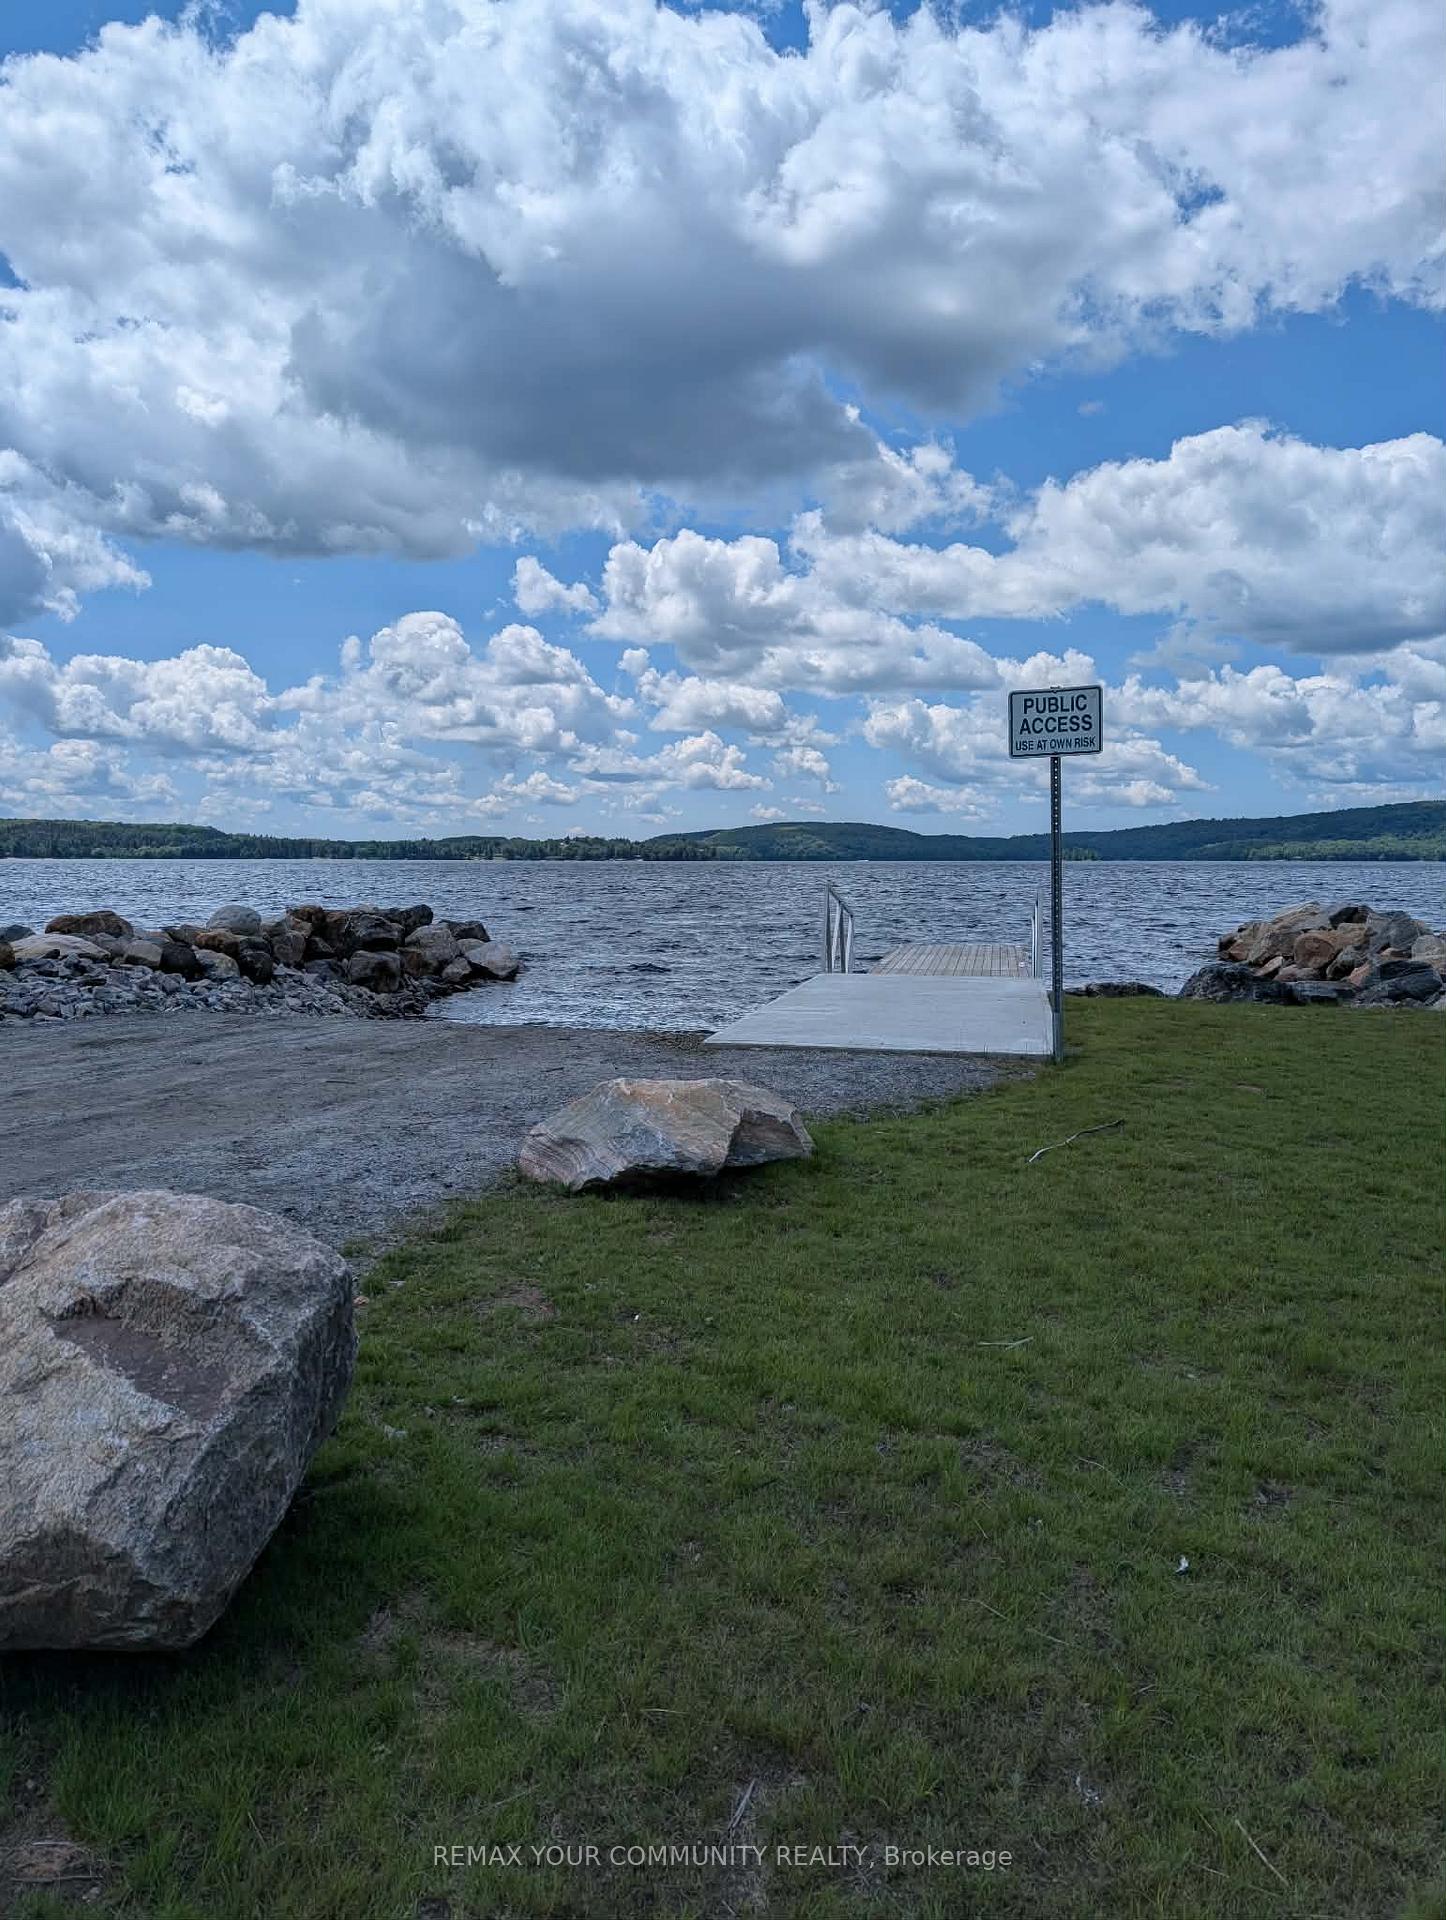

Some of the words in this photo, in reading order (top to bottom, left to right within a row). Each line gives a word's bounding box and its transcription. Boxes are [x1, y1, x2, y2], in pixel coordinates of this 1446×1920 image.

[1023, 694, 1087, 714] PUBLIC
[1019, 714, 1092, 735] ACCESS
[1015, 740, 1034, 751] USE
[1036, 739, 1048, 750] AT
[1050, 738, 1072, 749] OWN
[1074, 736, 1096, 748] RISK
